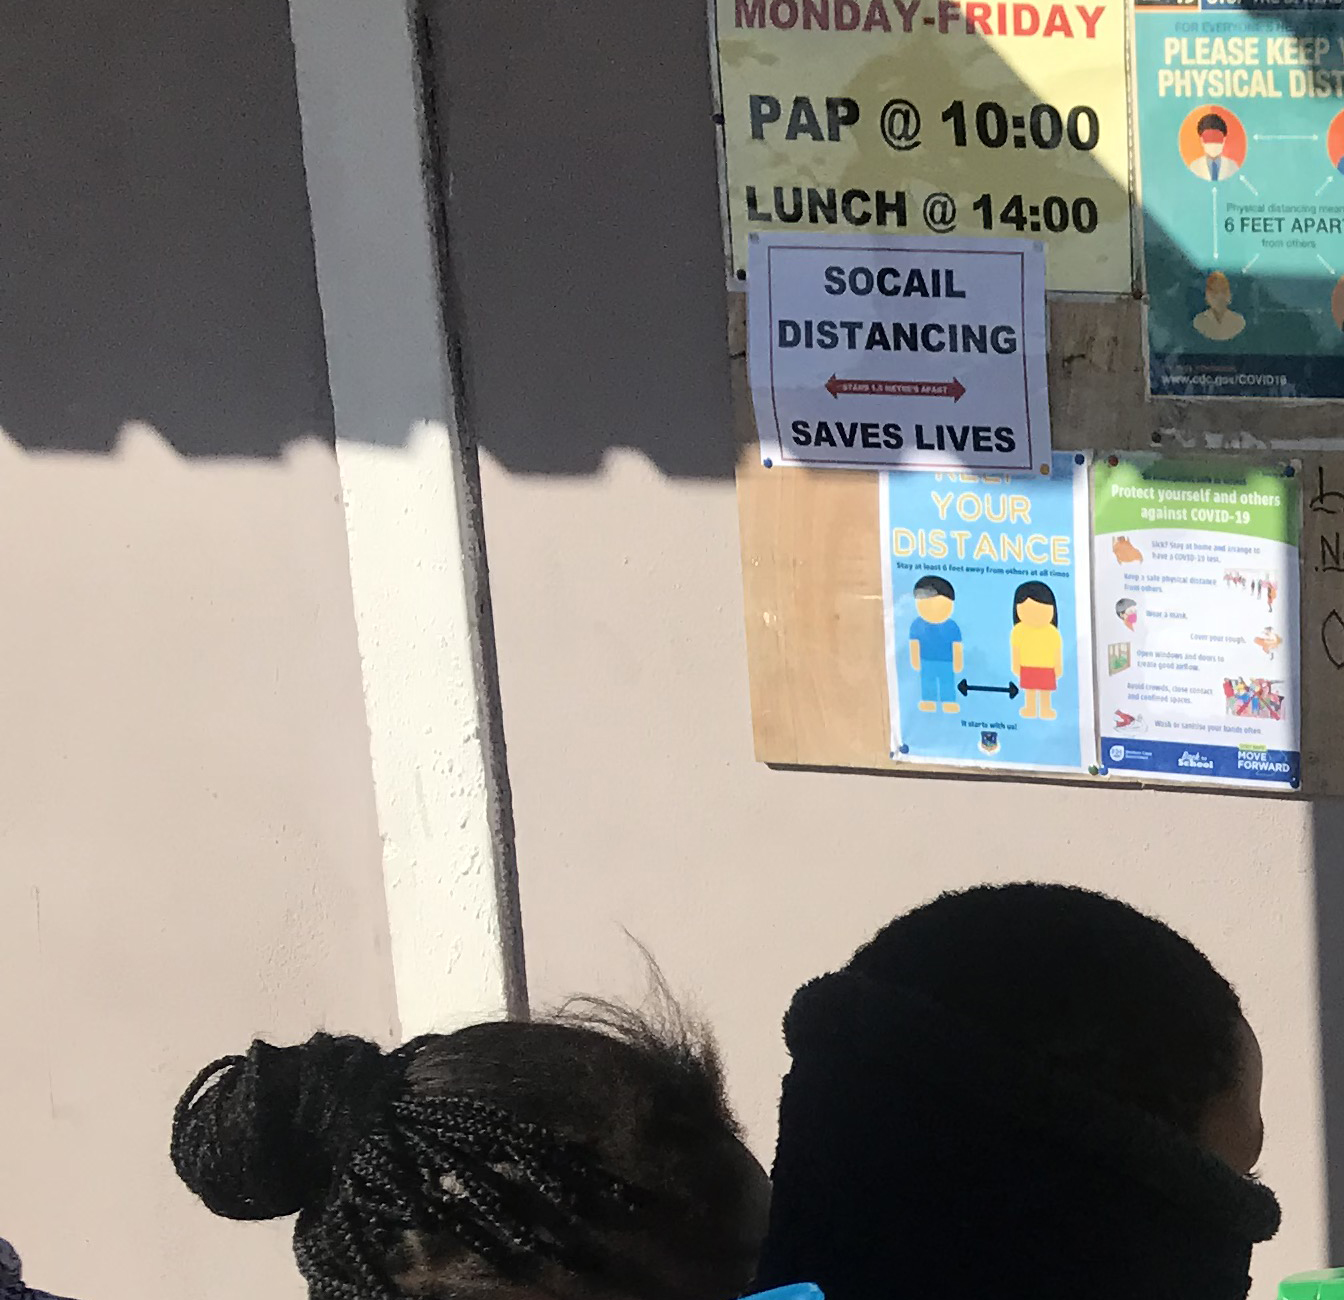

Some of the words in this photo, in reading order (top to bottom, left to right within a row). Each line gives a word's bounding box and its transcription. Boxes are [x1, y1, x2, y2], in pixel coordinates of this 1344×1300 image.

[735, 0, 1105, 39] MONDAY-FRIDAY
[1164, 37, 1259, 65] PLEASE
[1266, 38, 1330, 65] KEEP
[1158, 69, 1283, 98] PHYSICAL
[749, 95, 860, 142] PAP
[880, 99, 921, 150] @
[941, 101, 1100, 150] 10:00
[746, 187, 906, 227] LUNCH
[923, 193, 957, 234] @
[972, 194, 1098, 233] 14:00
[1226, 202, 1265, 215] Physical
[1268, 202, 1317, 215] distancing
[1224, 217, 1234, 232] 6
[1240, 217, 1286, 232] FEET
[1262, 238, 1283, 248] from
[1286, 239, 1316, 248] others
[825, 266, 966, 298] SOCAIL
[778, 320, 1017, 354] DISTANCING
[791, 421, 903, 450] SAVES
[915, 424, 1016, 452] LIVES
[931, 491, 1031, 524] YOUR
[1111, 484, 1155, 500] Protect
[1158, 488, 1211, 503] yourself
[1213, 490, 1237, 504] and
[1240, 492, 1281, 507] others
[1141, 506, 1187, 521] against
[1190, 508, 1250, 524] COVID-19
[893, 528, 1070, 565] DISTANCE
[897, 562, 913, 571] Stay
[923, 563, 941, 571] least
[966, 566, 984, 574] away
[986, 566, 1004, 574] from
[1178, 758, 1213, 769] School
[1238, 751, 1267, 761] MOVE
[1238, 760, 1290, 772] FORWARD
